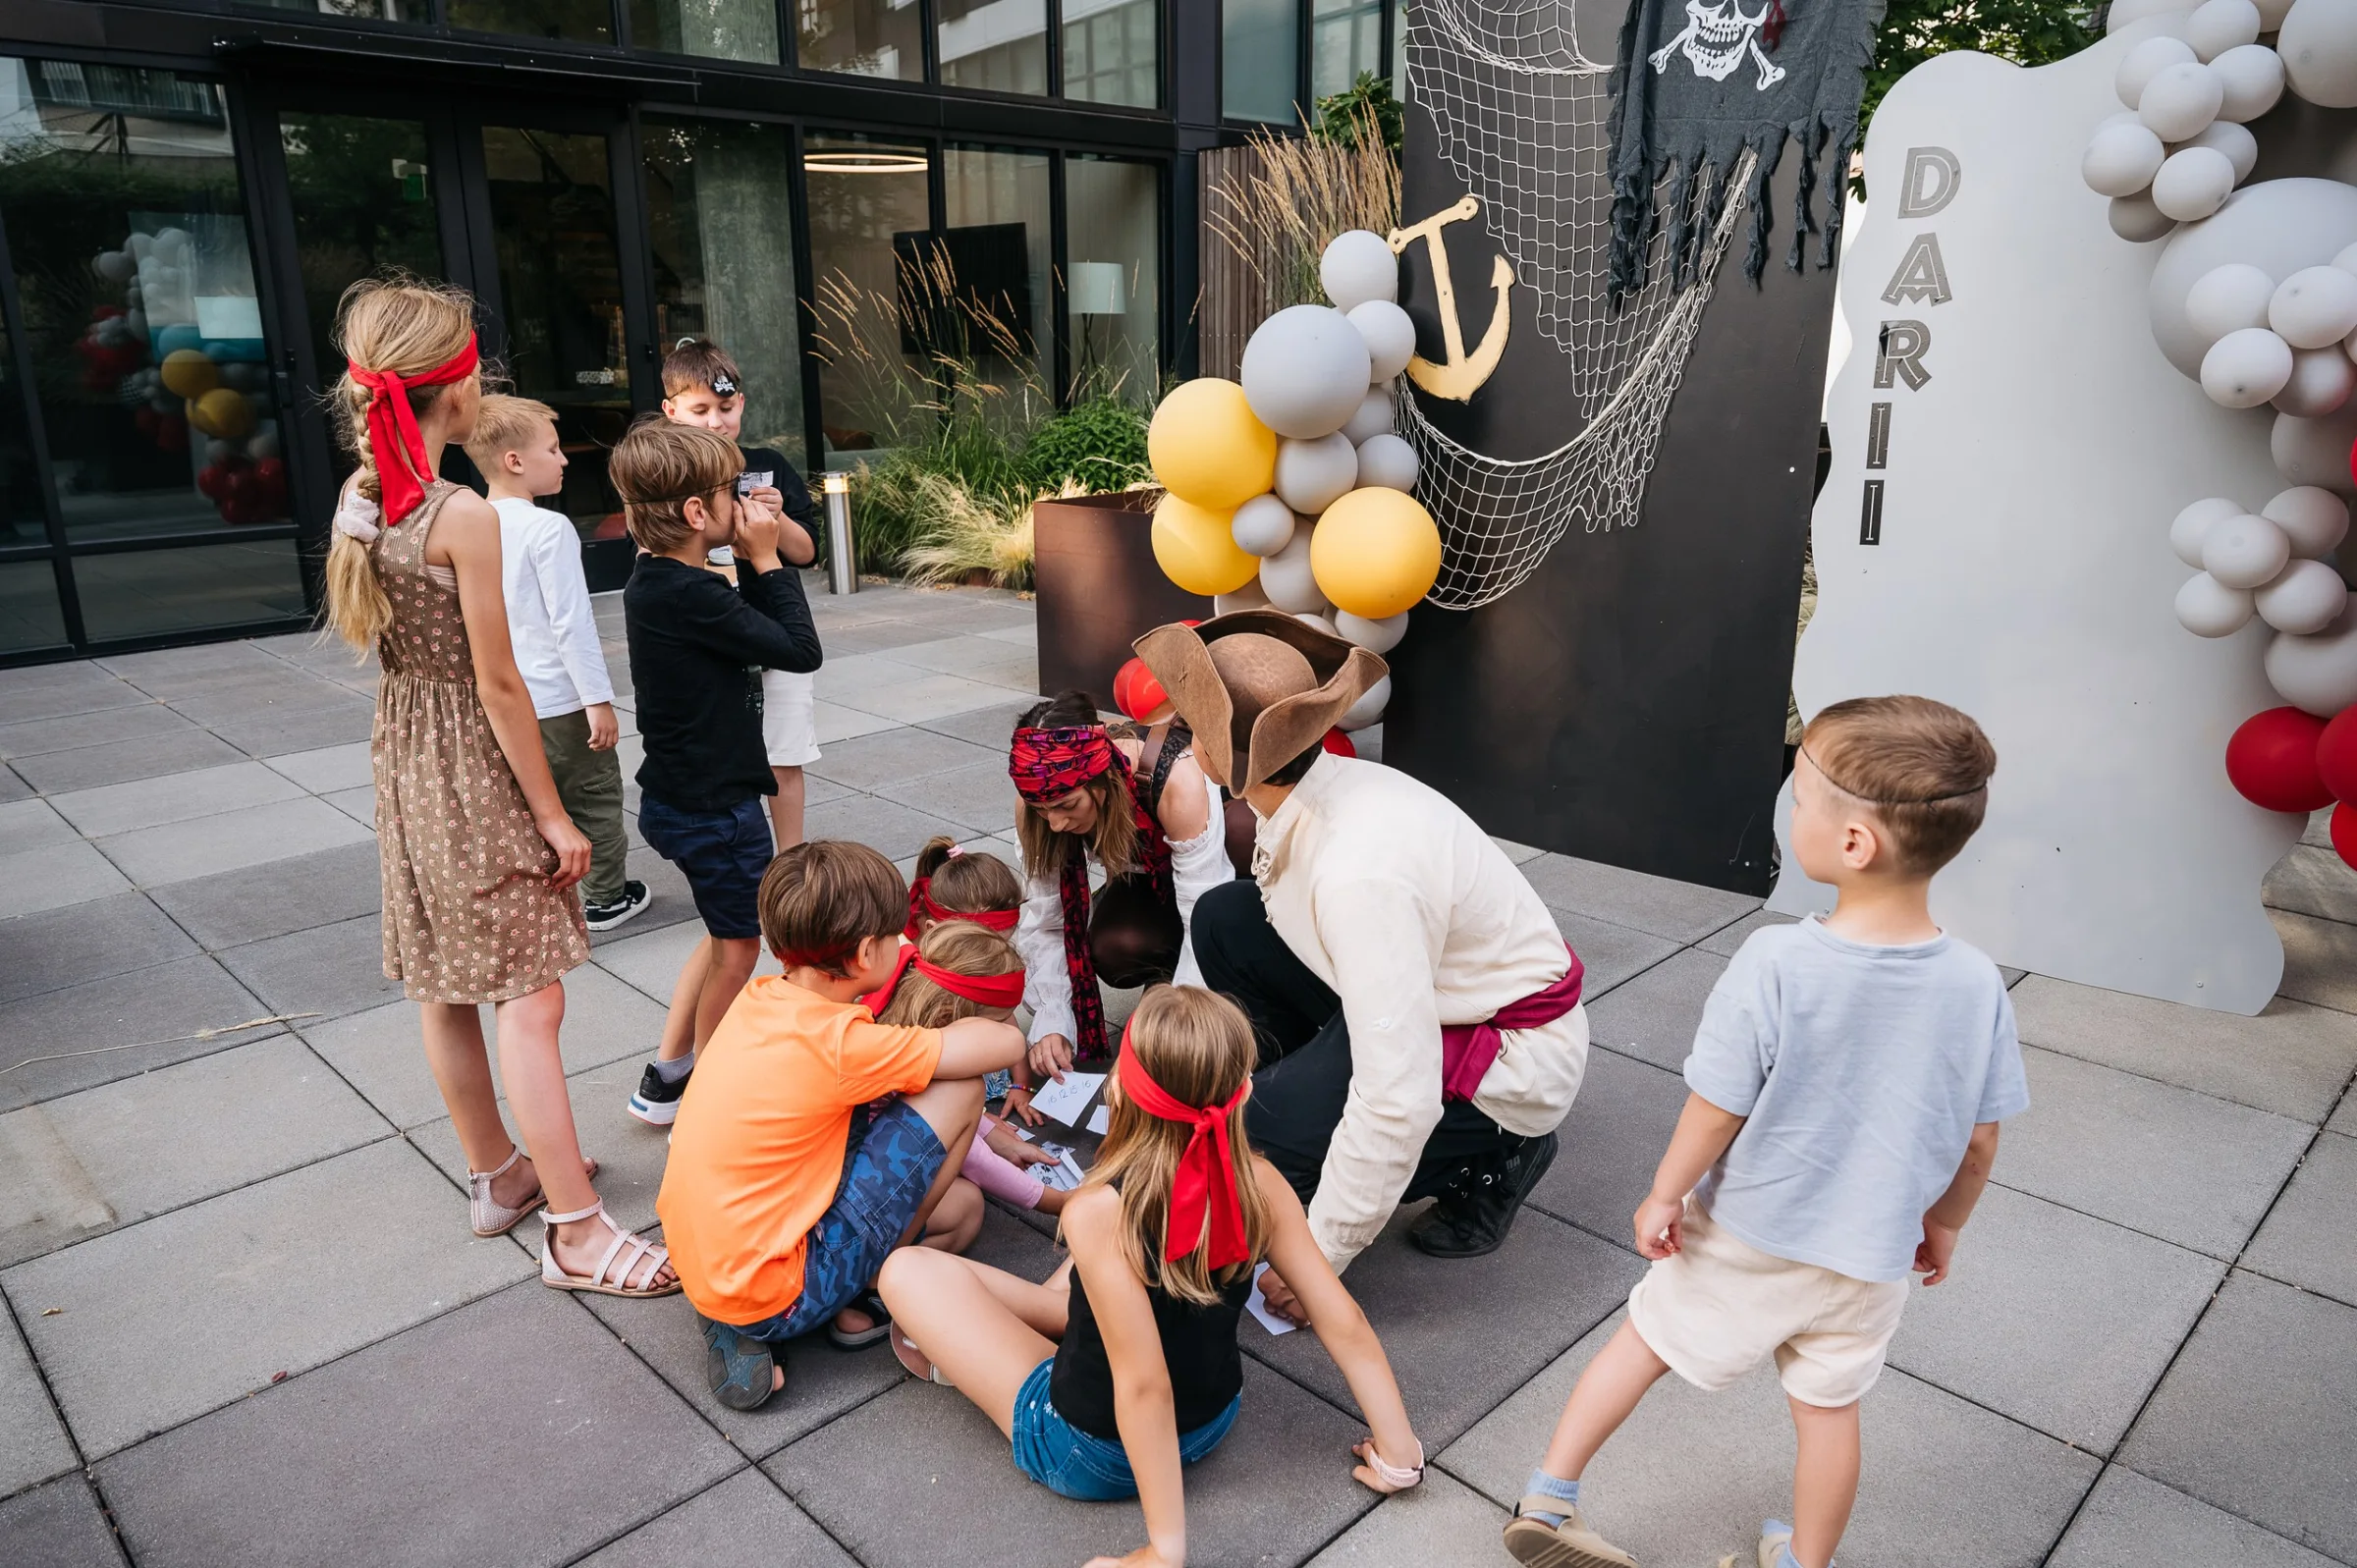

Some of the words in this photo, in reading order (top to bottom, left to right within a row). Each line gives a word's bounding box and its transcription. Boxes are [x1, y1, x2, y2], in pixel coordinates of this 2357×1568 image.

[1859, 145, 1961, 546] DARII
[1059, 1088, 1069, 1100] 12
[1081, 1079, 1092, 1089] 16
